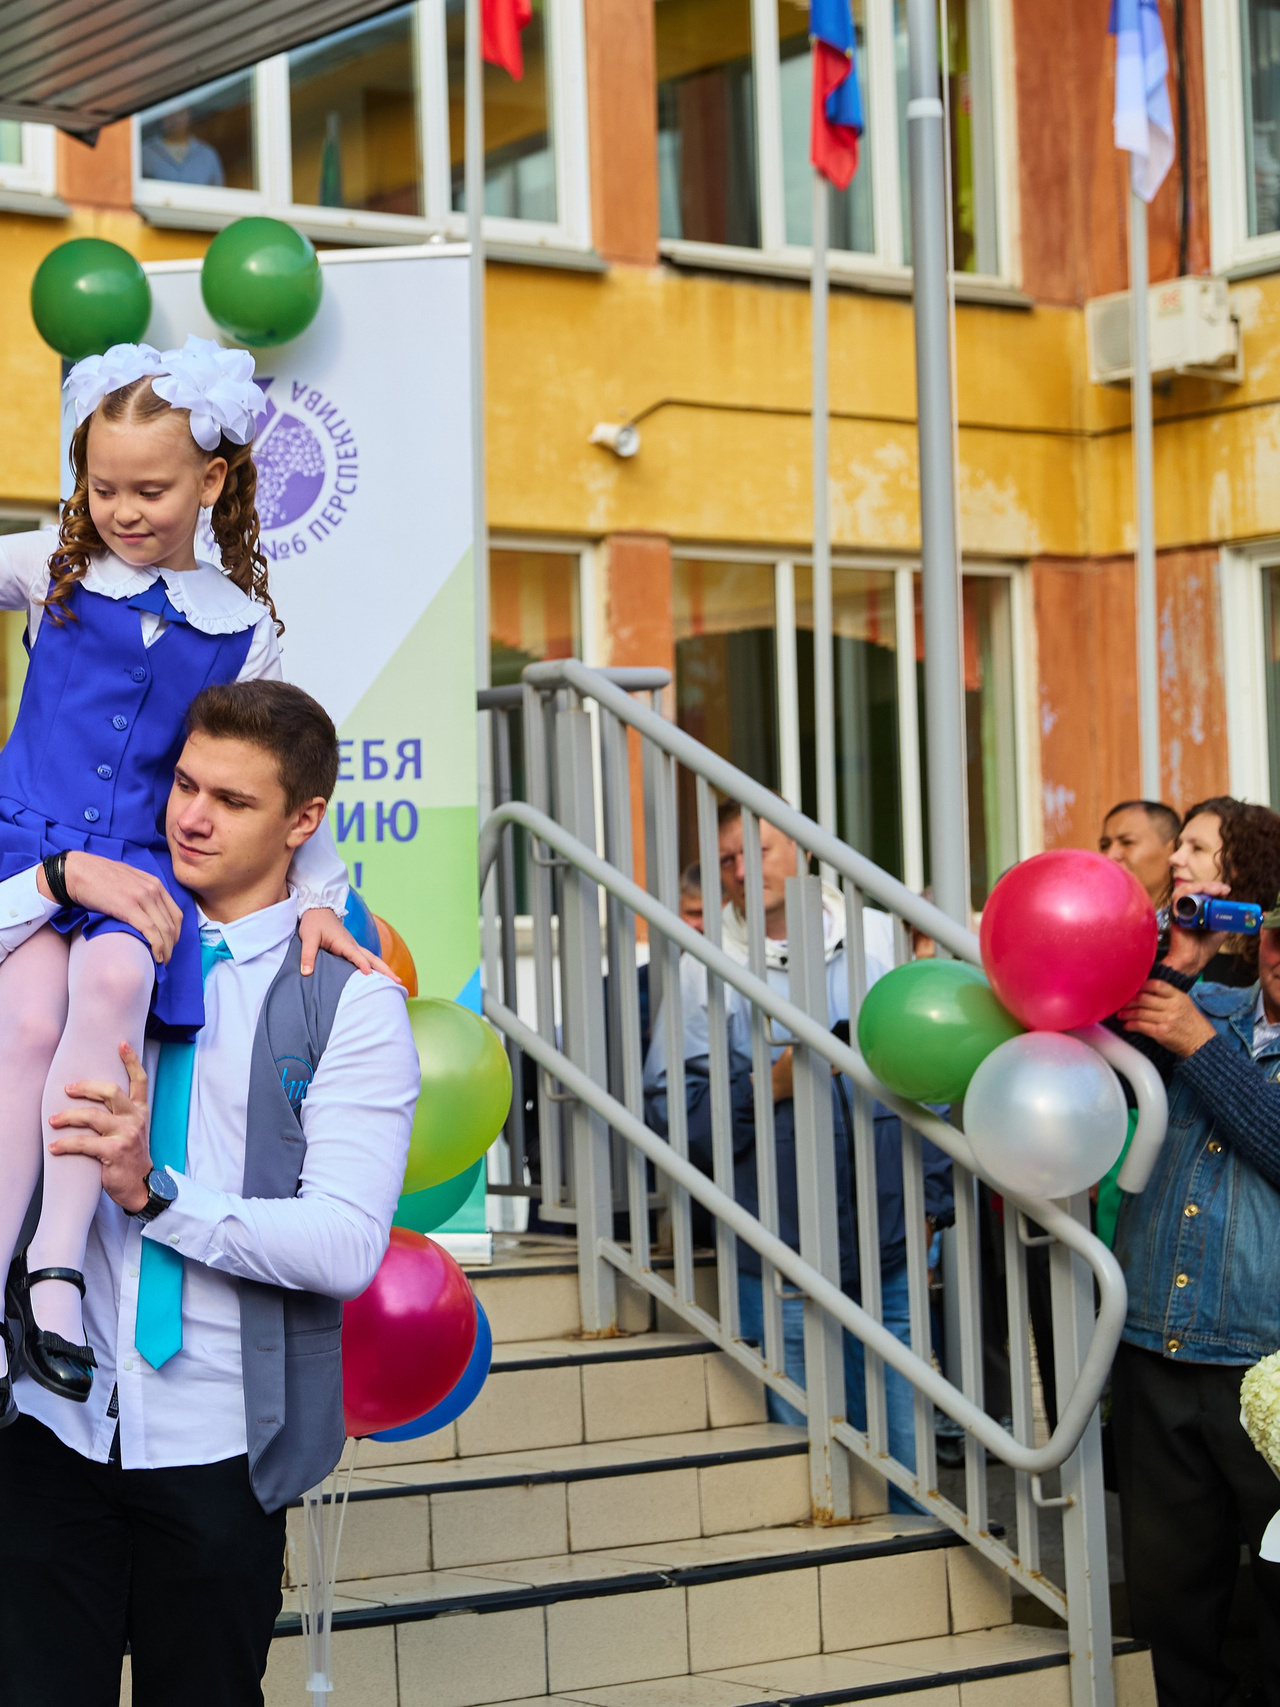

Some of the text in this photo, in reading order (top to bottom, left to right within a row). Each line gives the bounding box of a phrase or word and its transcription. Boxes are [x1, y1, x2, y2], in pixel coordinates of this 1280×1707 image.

[291, 379, 359, 542] ПЕРСПЕКТИВА
[336, 738, 422, 781] ЕБЯ
[336, 799, 419, 843] ИЮ
